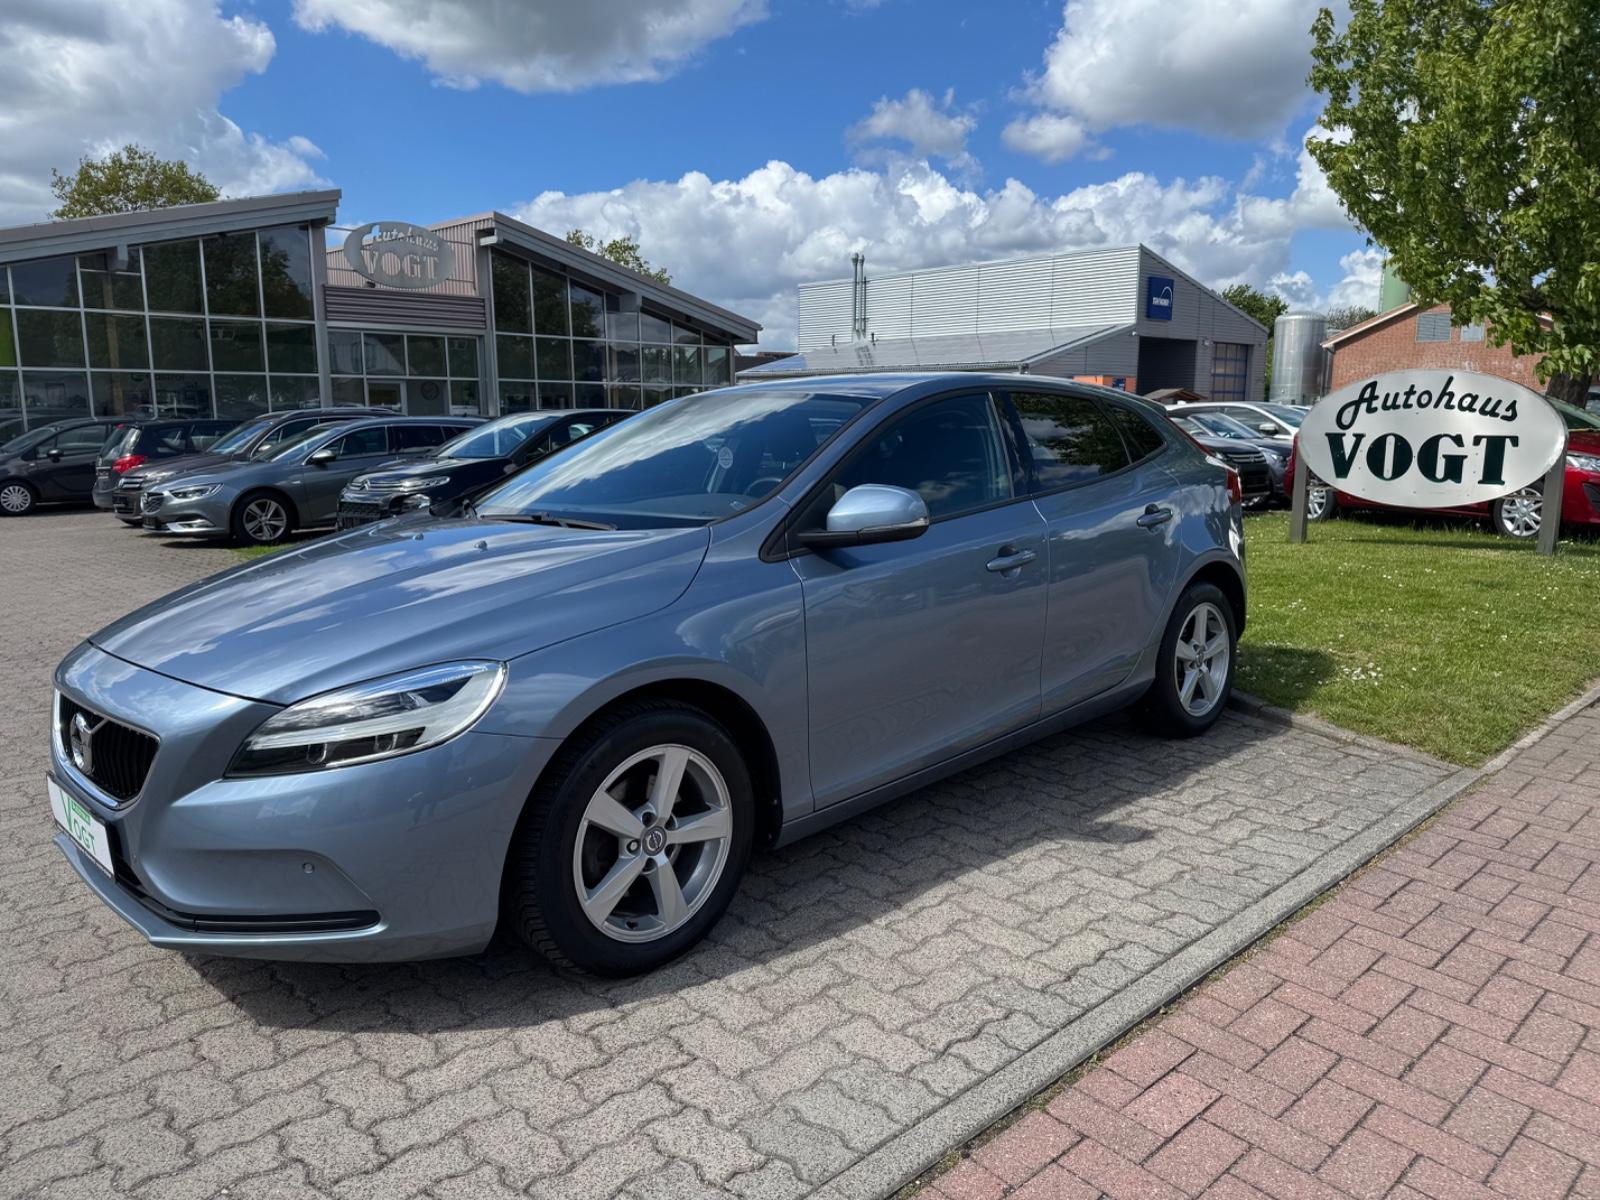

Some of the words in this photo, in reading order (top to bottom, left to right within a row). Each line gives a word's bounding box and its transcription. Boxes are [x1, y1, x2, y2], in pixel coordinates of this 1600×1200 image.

[361, 250, 440, 280] VOGT
[1335, 375, 1518, 430] Autohaus
[1324, 432, 1519, 485] VOGT
